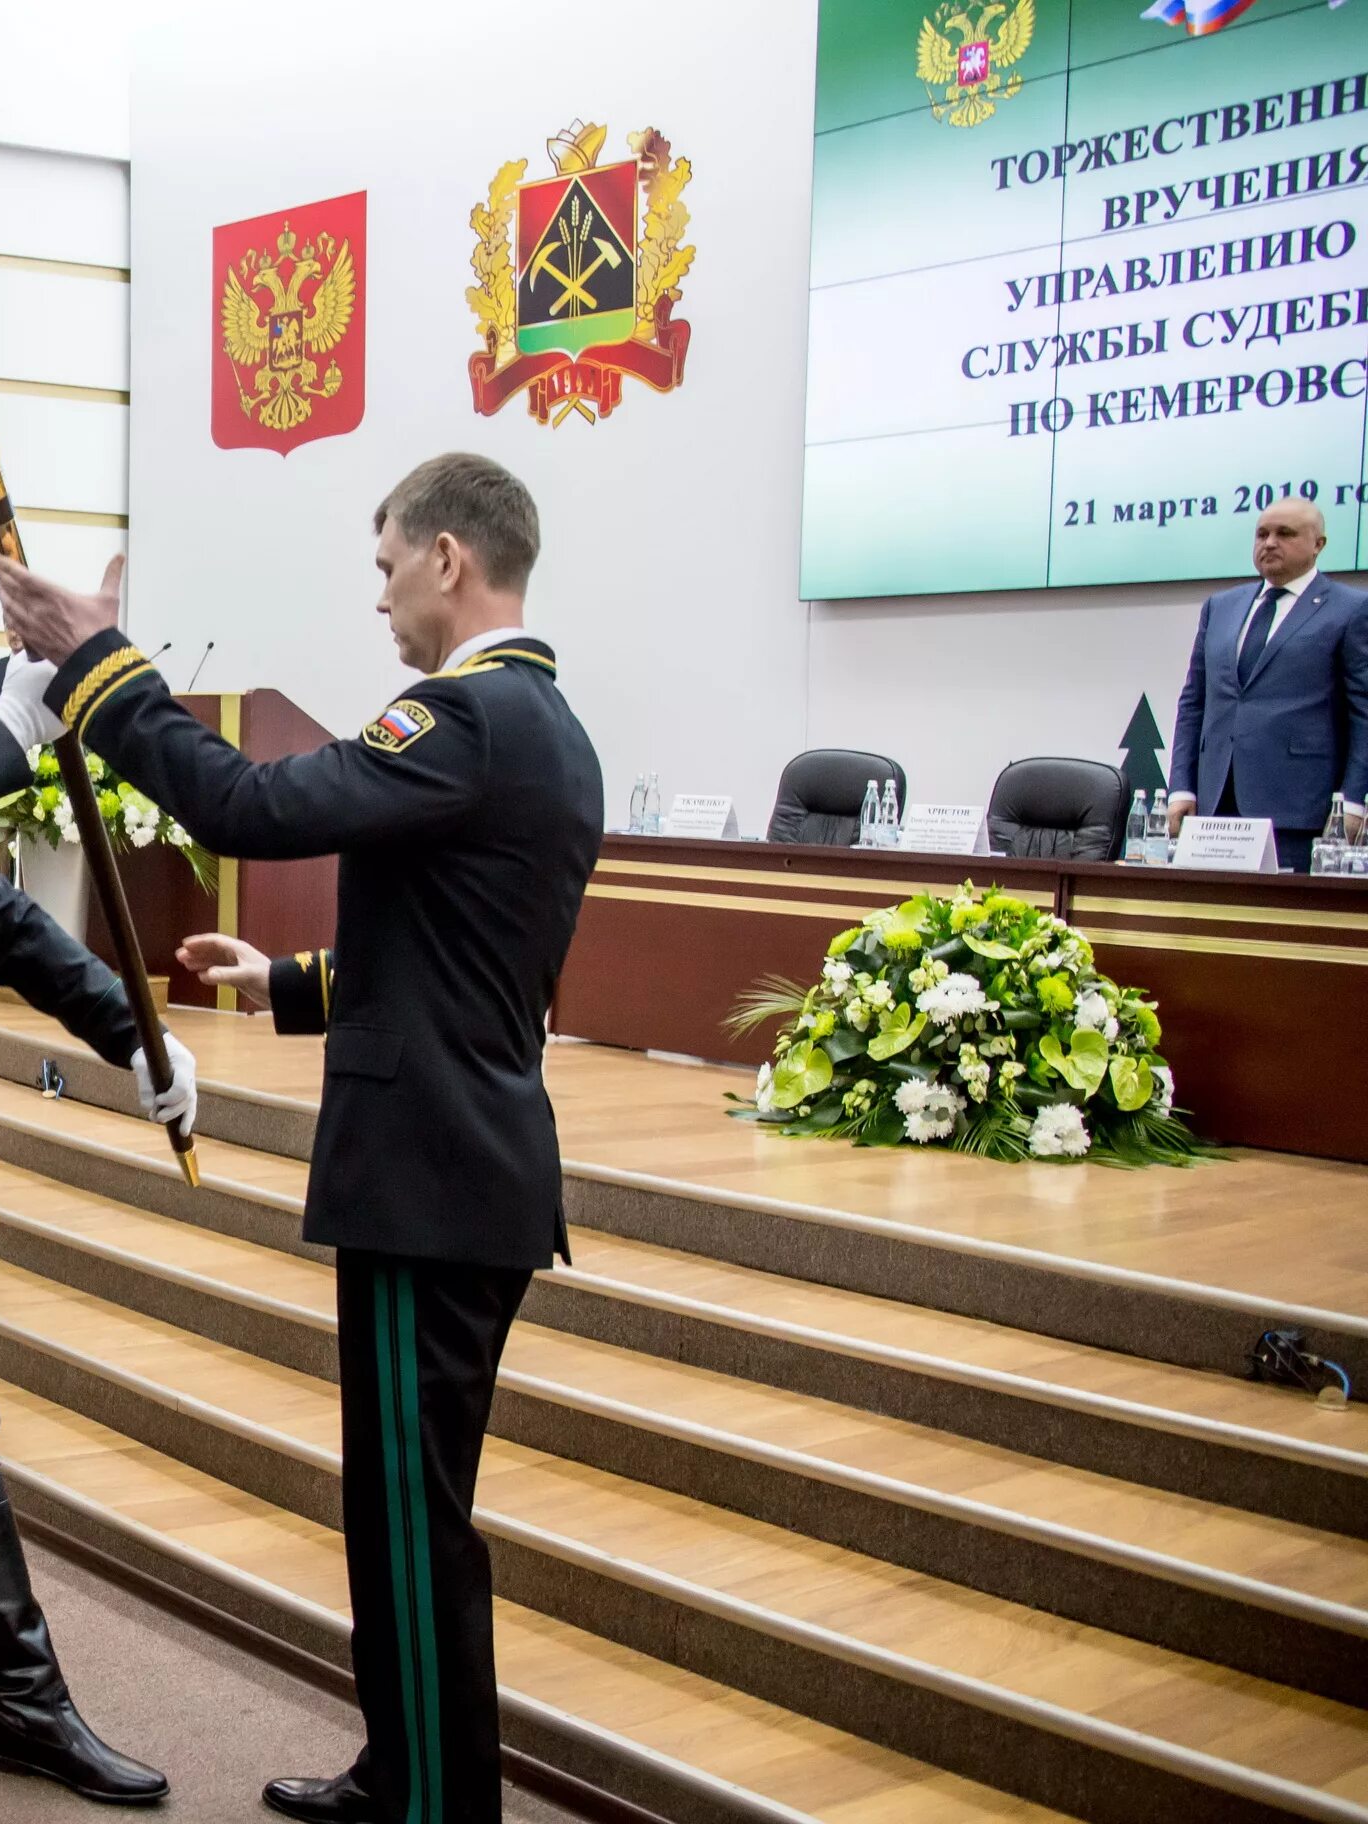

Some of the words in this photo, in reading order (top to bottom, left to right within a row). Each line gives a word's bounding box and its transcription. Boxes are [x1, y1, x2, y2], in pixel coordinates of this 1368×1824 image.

[990, 72, 1368, 191] ТОРЖЕСТВЕНН
[1100, 143, 1368, 232] ВРУЧЕНИЯ
[1003, 220, 1357, 312] УПРАВЛЕНИЮ
[961, 318, 1169, 380] СЛУЖБЫ
[1007, 396, 1074, 437] ПО
[1085, 358, 1367, 429] КЕМЕРОВС
[1064, 499, 1097, 527] 21
[1112, 495, 1218, 527] марта
[1232, 479, 1319, 514] 2019
